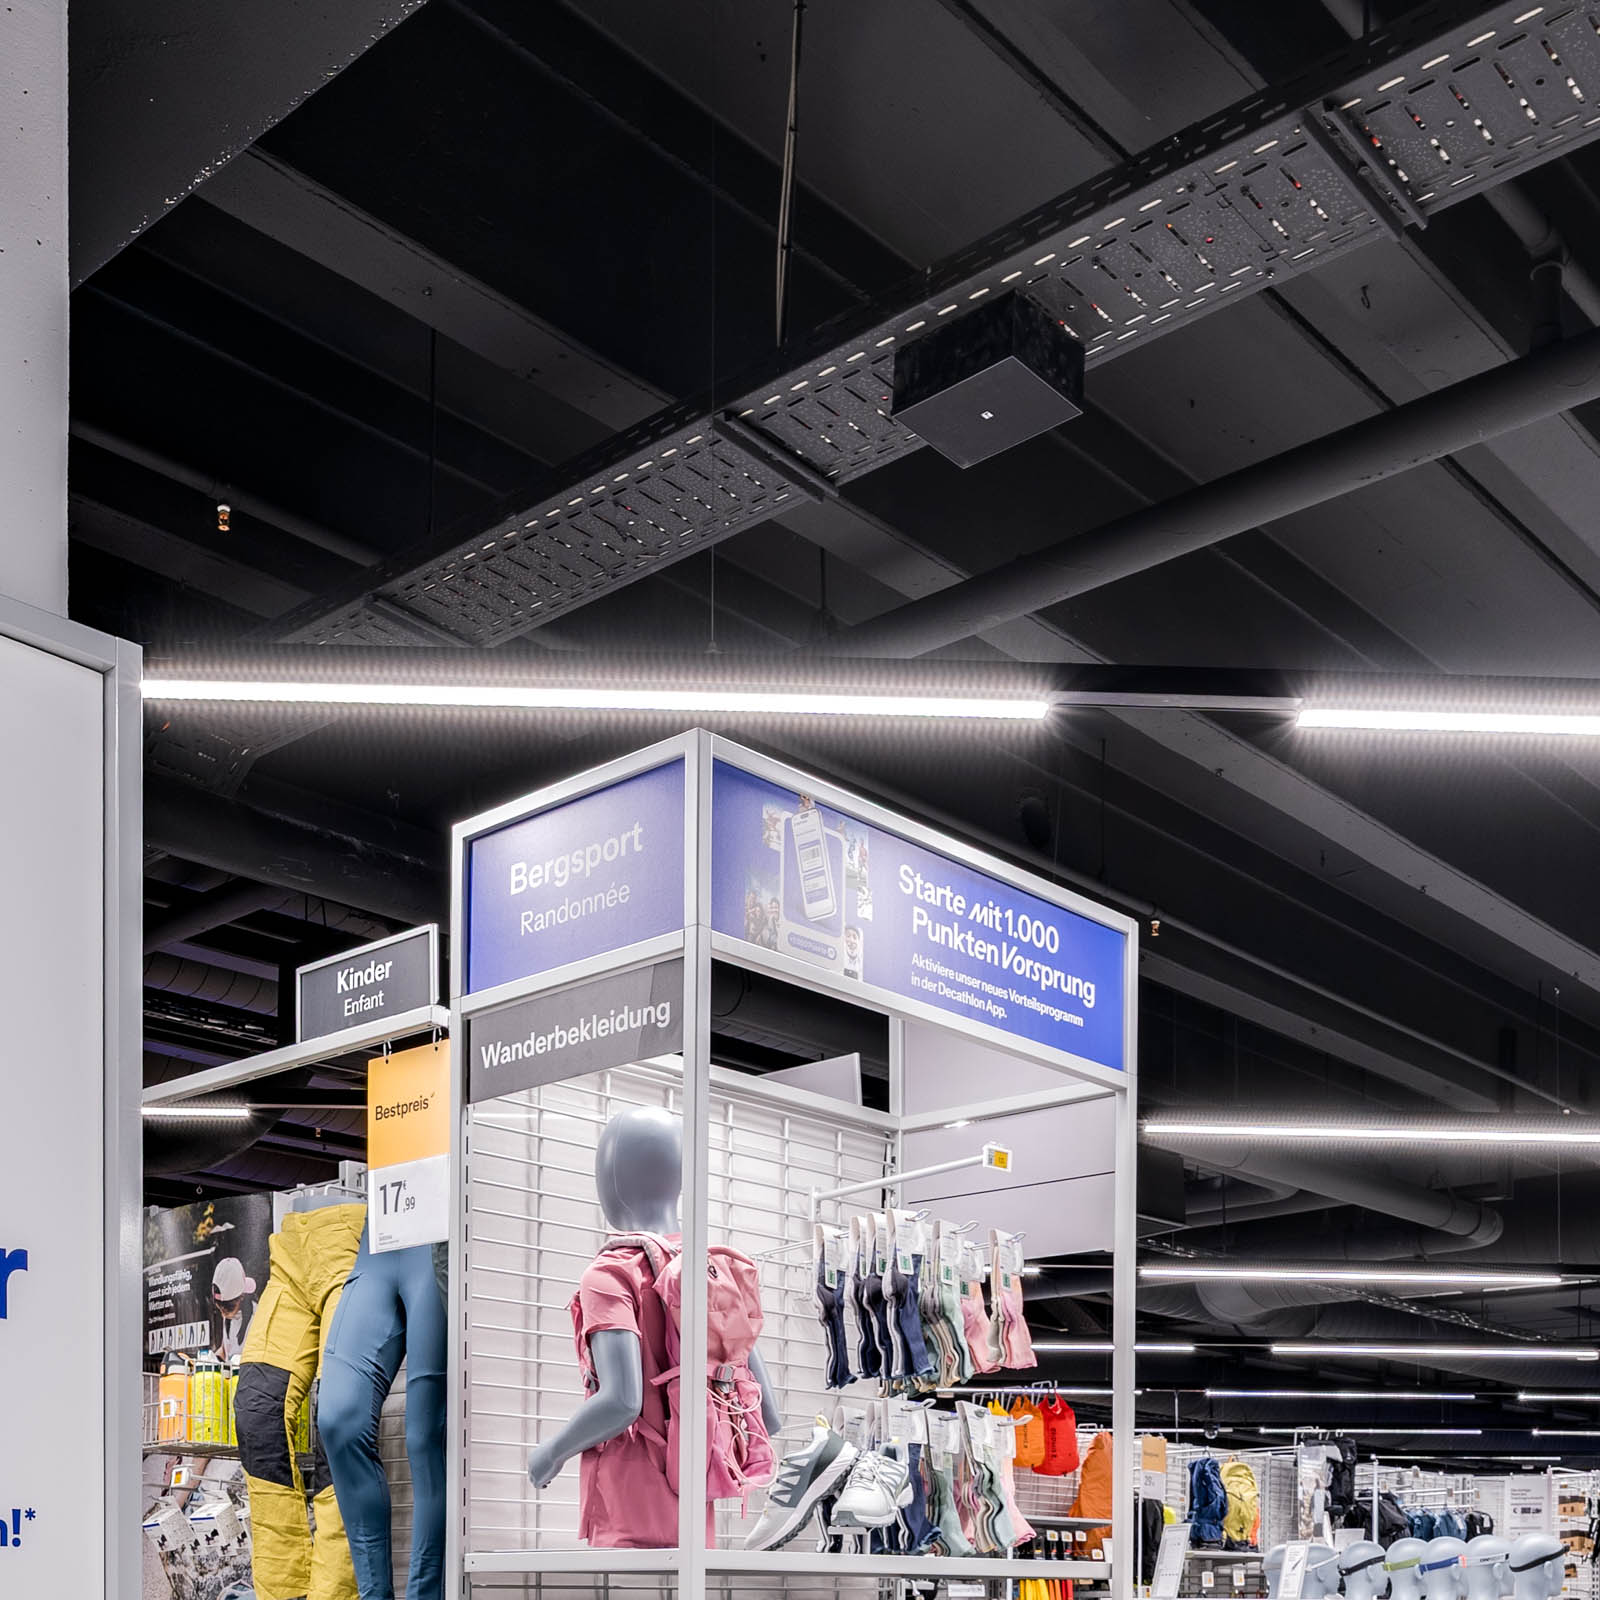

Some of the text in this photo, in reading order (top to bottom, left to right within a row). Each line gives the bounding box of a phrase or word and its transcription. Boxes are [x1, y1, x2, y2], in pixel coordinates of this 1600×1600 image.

[510, 821, 644, 895] Bergsport
[520, 882, 631, 936] Randonnée
[899, 864, 966, 916] Starte
[1004, 909, 1060, 954] 1.000
[337, 960, 392, 994] Kinder
[912, 906, 999, 966] Punkten
[1002, 942, 1095, 1008] Vorsprung
[344, 990, 384, 1017] Enfant
[911, 953, 1084, 1027] Aktiviere unser neues Vorteilsprogramm
[911, 972, 1007, 1020] in der Decathlon App.
[481, 1001, 671, 1069] Wanderbekleidung
[375, 1096, 429, 1121] Bestpreis
